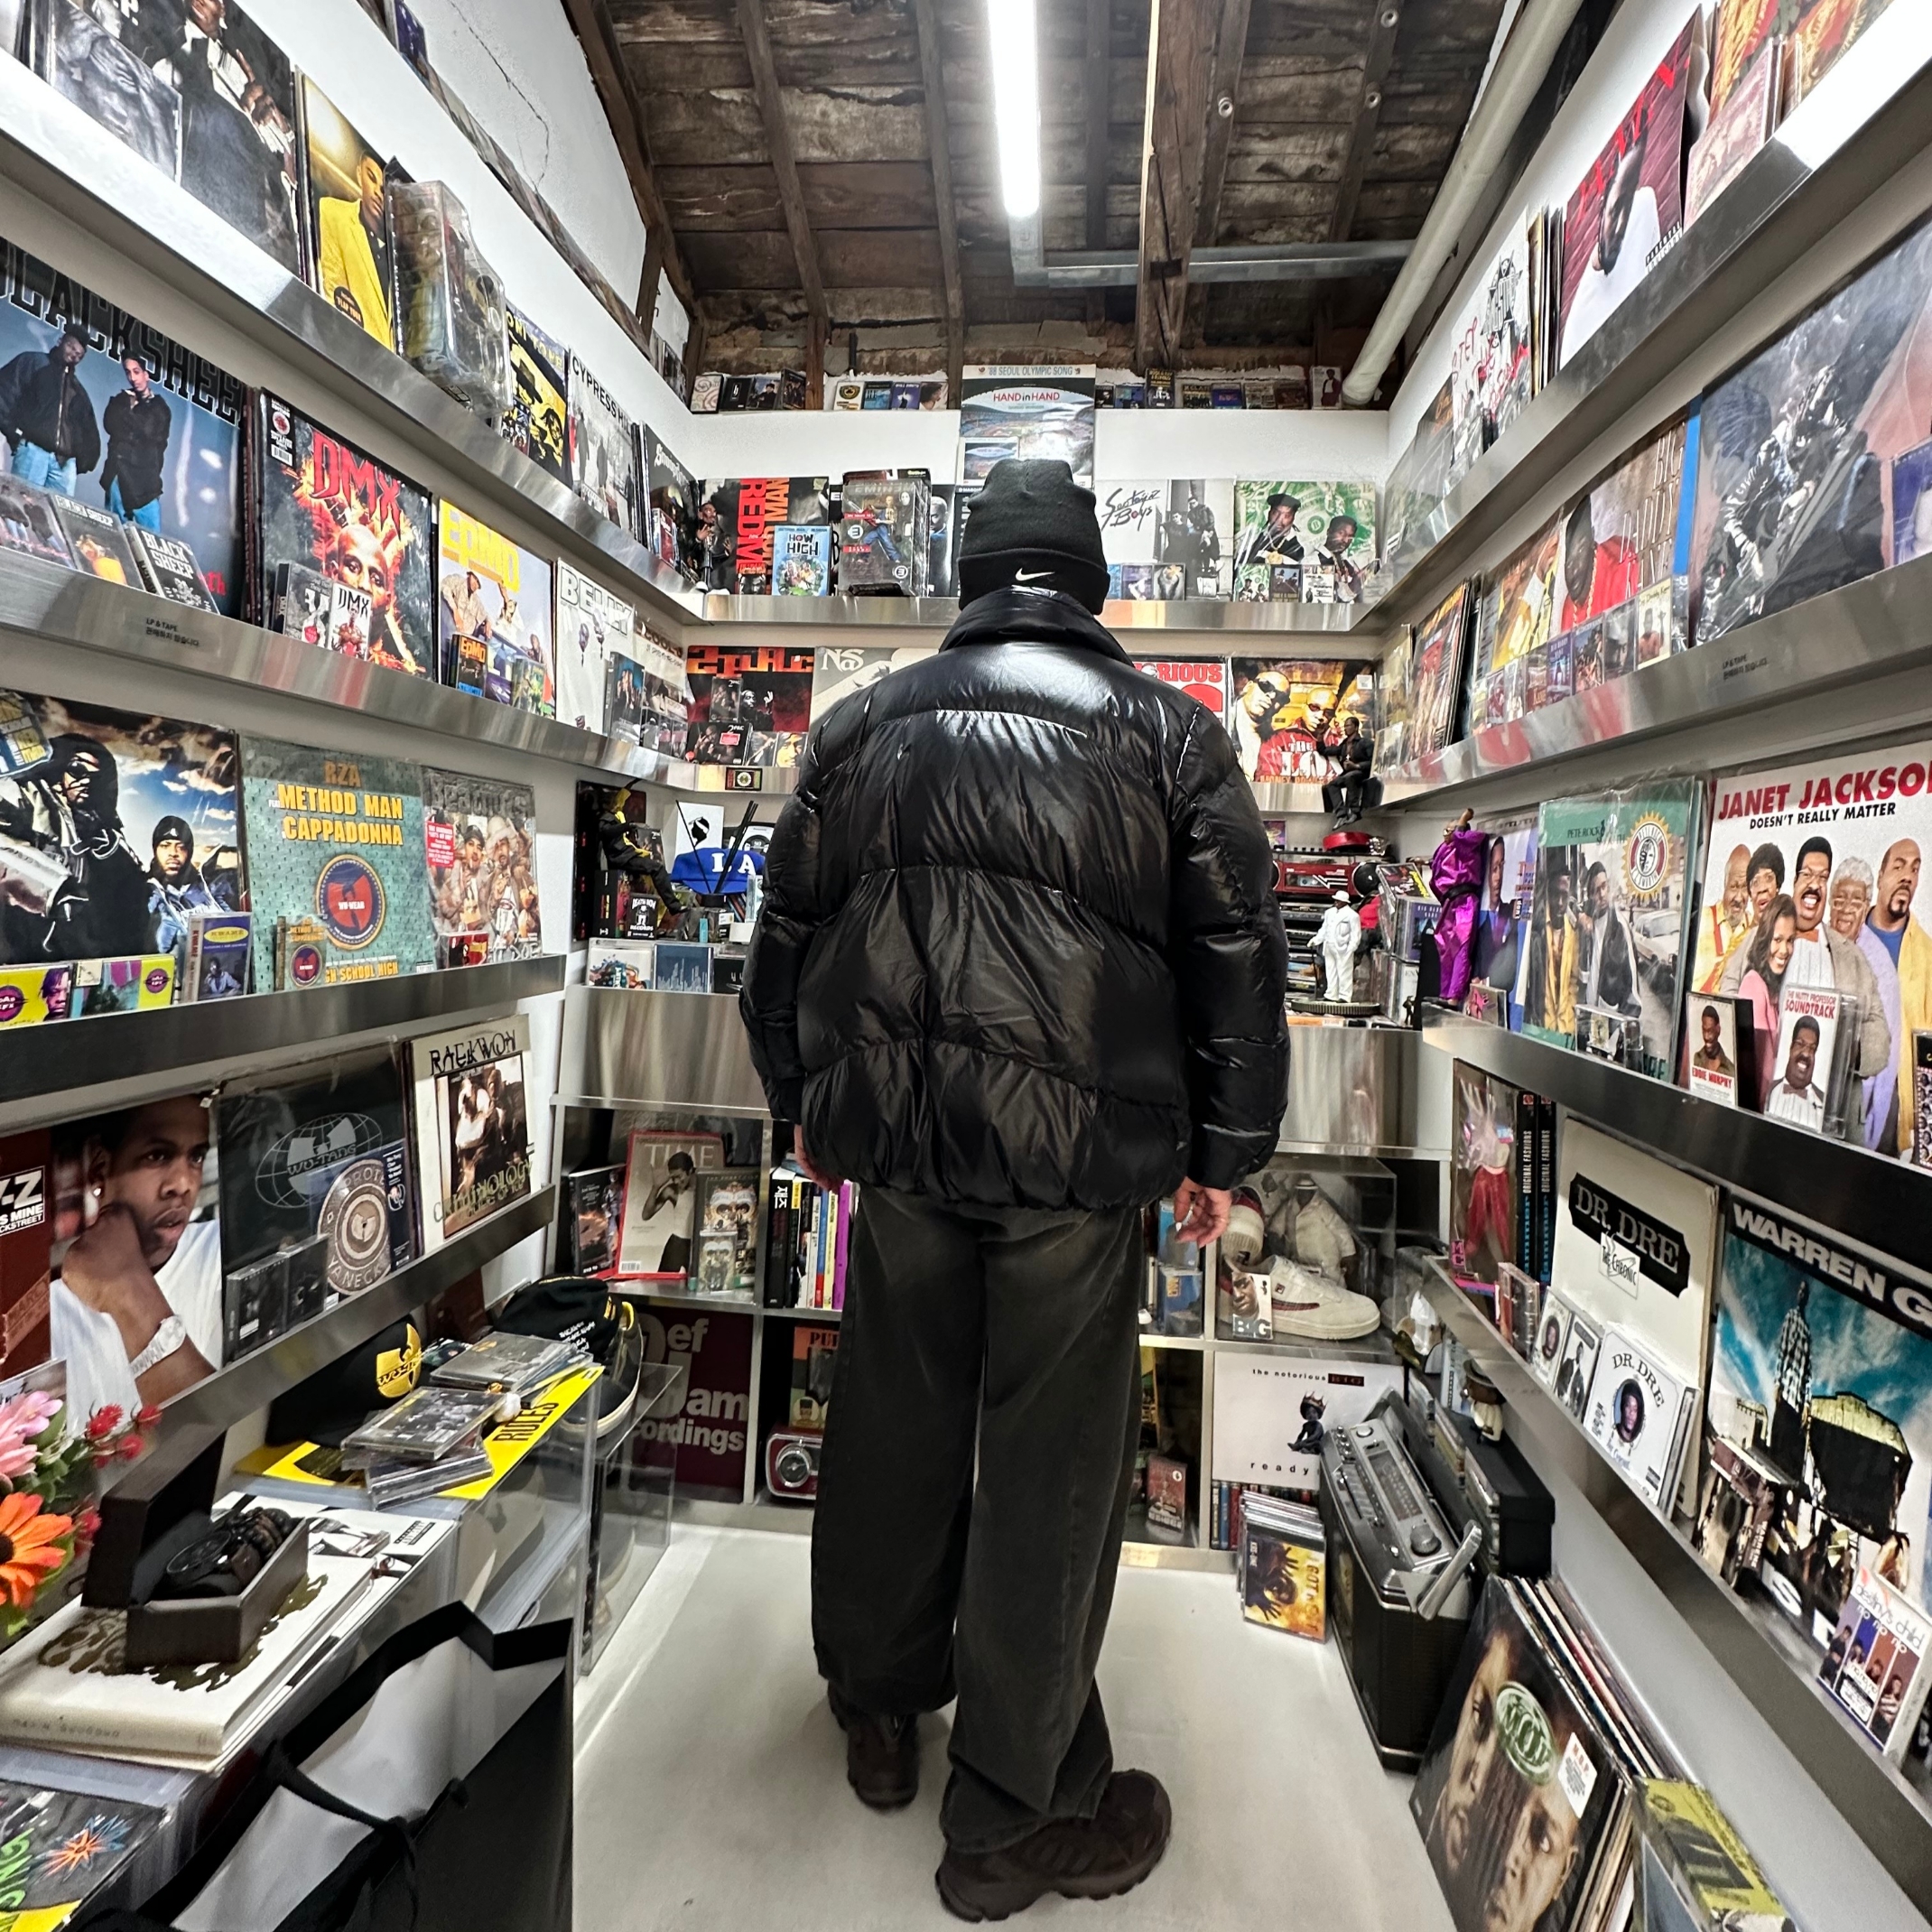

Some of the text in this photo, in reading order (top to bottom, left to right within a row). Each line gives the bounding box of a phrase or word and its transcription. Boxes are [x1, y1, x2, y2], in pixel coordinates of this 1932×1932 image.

[999, 367, 1020, 376] SEOUL
[1022, 367, 1052, 376] OLYMPIC
[1053, 367, 1073, 376] SONG
[571, 356, 618, 418] CYPRESS
[993, 393, 1021, 402] HAND
[1031, 392, 1061, 401] HAND
[309, 424, 402, 542] DMX
[736, 478, 767, 575] REDM
[788, 534, 814, 543] HOW
[142, 530, 190, 564] BLACK
[786, 541, 819, 556] HIGH
[150, 548, 194, 580] SHEEP
[559, 565, 633, 636] BELLY
[162, 620, 178, 632] TAPE
[325, 760, 361, 787] RZA
[277, 784, 358, 814] METHOD
[365, 794, 404, 820] MAN
[1718, 761, 1932, 820] JANET JACKSO
[1750, 802, 1896, 830] DOESN'T REALLY MATTER
[283, 816, 404, 846] CAPPADONNA
[339, 963, 375, 981] SCHOOL
[378, 961, 397, 976] HIGH
[1785, 999, 1835, 1019] SOUNDTRACK
[429, 1031, 516, 1076] RAEKWON
[1692, 1066, 1732, 1089] EDDIE MURPHY
[287, 1142, 357, 1176] WU-TANG
[645, 1143, 715, 1168] TIME
[1522, 1130, 1532, 1164] FASHIONS
[11, 1203, 44, 1221] MINE
[774, 1185, 788, 1210] 재즈
[0, 1213, 43, 1233] CKSTREET
[1574, 1184, 1681, 1275] DR. DRE
[1732, 1203, 1932, 1327] WARREN G
[1252, 1368, 1269, 1376] the
[1274, 1371, 1327, 1381] notorious
[1612, 1352, 1665, 1408] DR. DRE
[631, 1417, 746, 1456] cordings
[1249, 1462, 1311, 1476] ready
